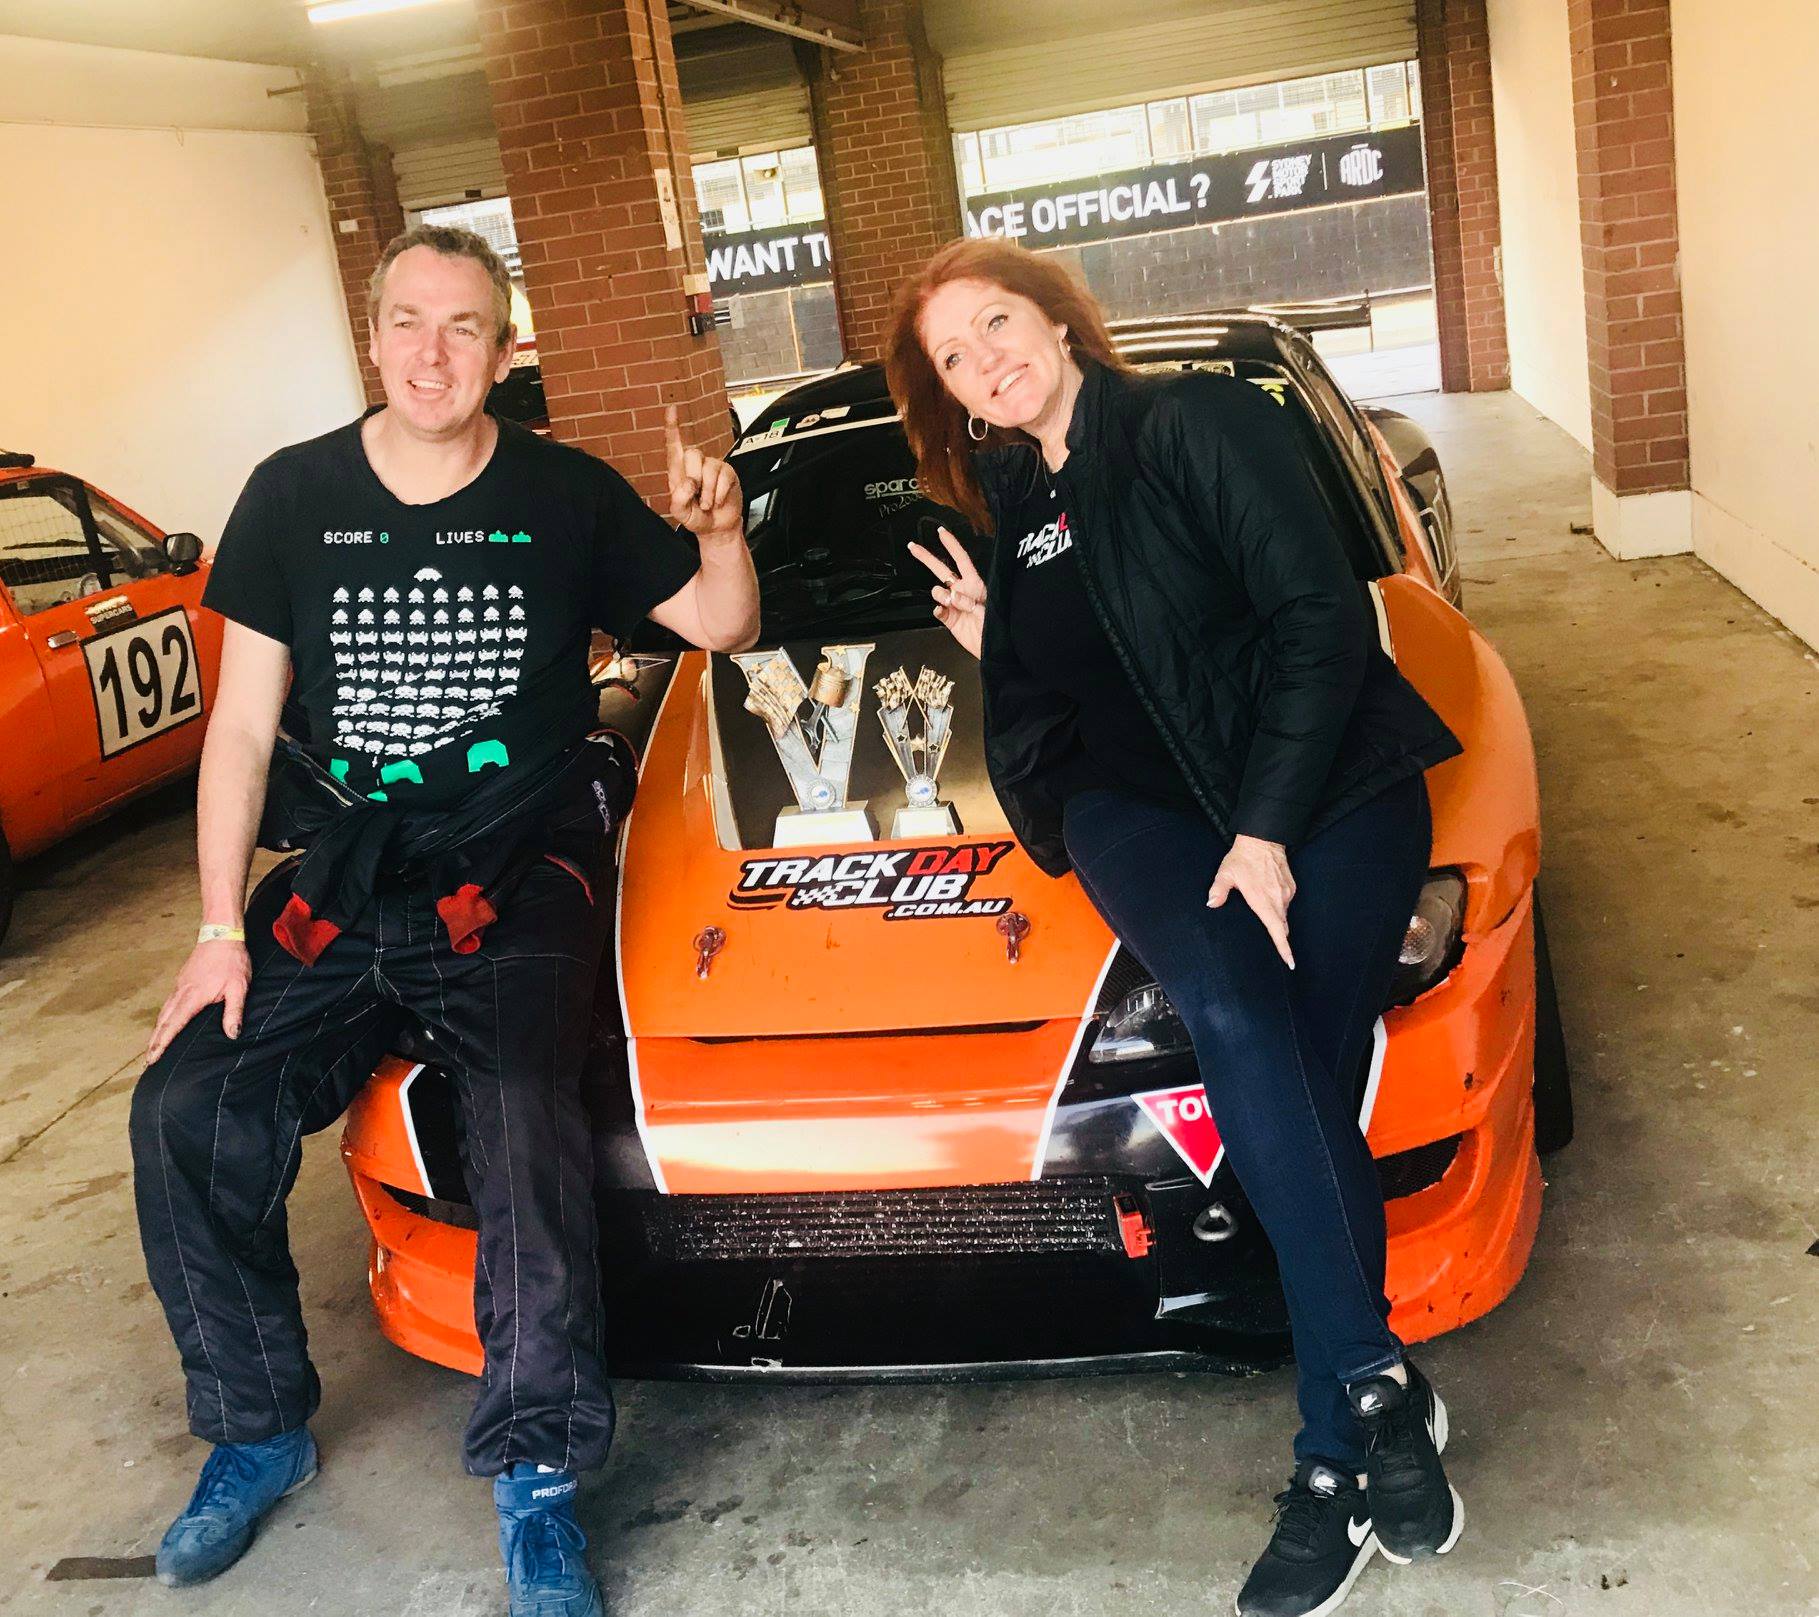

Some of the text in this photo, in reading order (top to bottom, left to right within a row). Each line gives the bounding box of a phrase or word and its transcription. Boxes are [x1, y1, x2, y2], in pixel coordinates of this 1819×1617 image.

[1339, 147, 1384, 186] ARDC
[705, 236, 798, 283] WANT
[323, 531, 390, 545] SCORE 0
[436, 530, 486, 545] LIVES
[99, 624, 196, 739] 192
[742, 845, 1010, 888] TRACK DAY
[822, 873, 969, 908] CLUB
[886, 900, 1006, 918] .COM.AU
